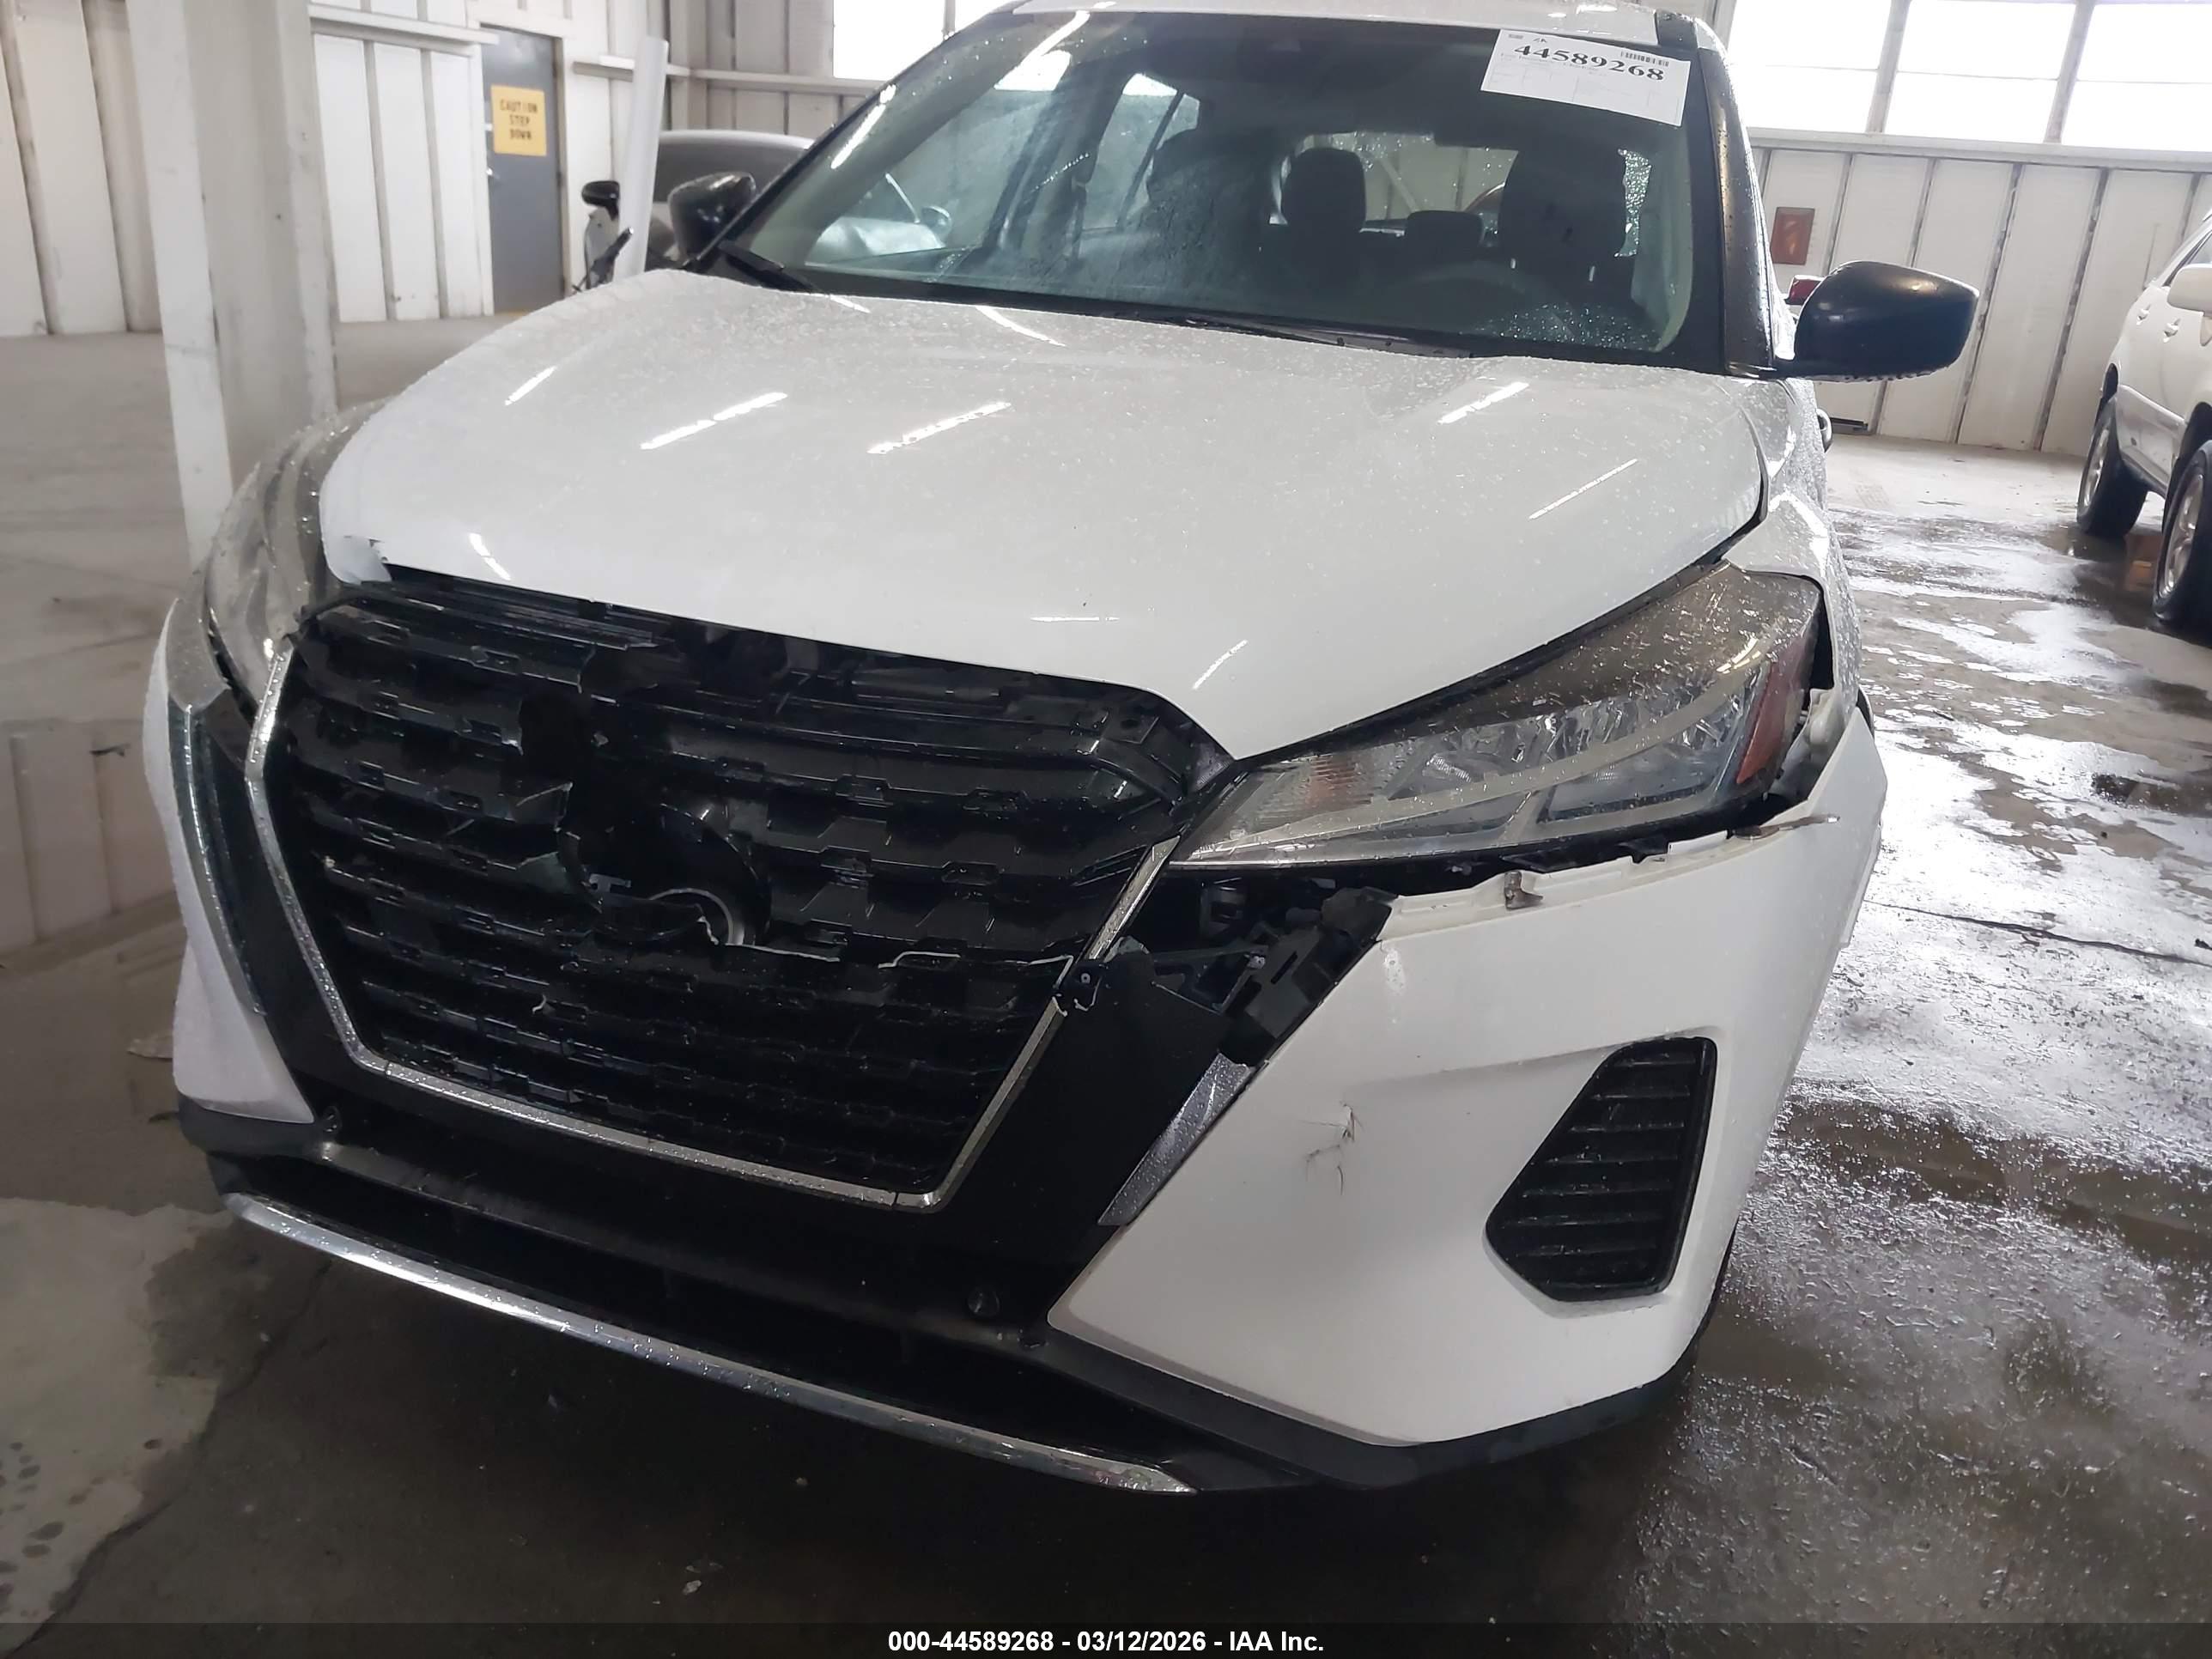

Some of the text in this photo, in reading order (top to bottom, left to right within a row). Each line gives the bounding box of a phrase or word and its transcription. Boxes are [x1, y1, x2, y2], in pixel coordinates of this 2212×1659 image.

[1513, 45, 1664, 81] 44589268
[500, 99, 538, 112] CAUTION
[509, 114, 530, 125] STEP
[509, 129, 532, 140] DOWN
